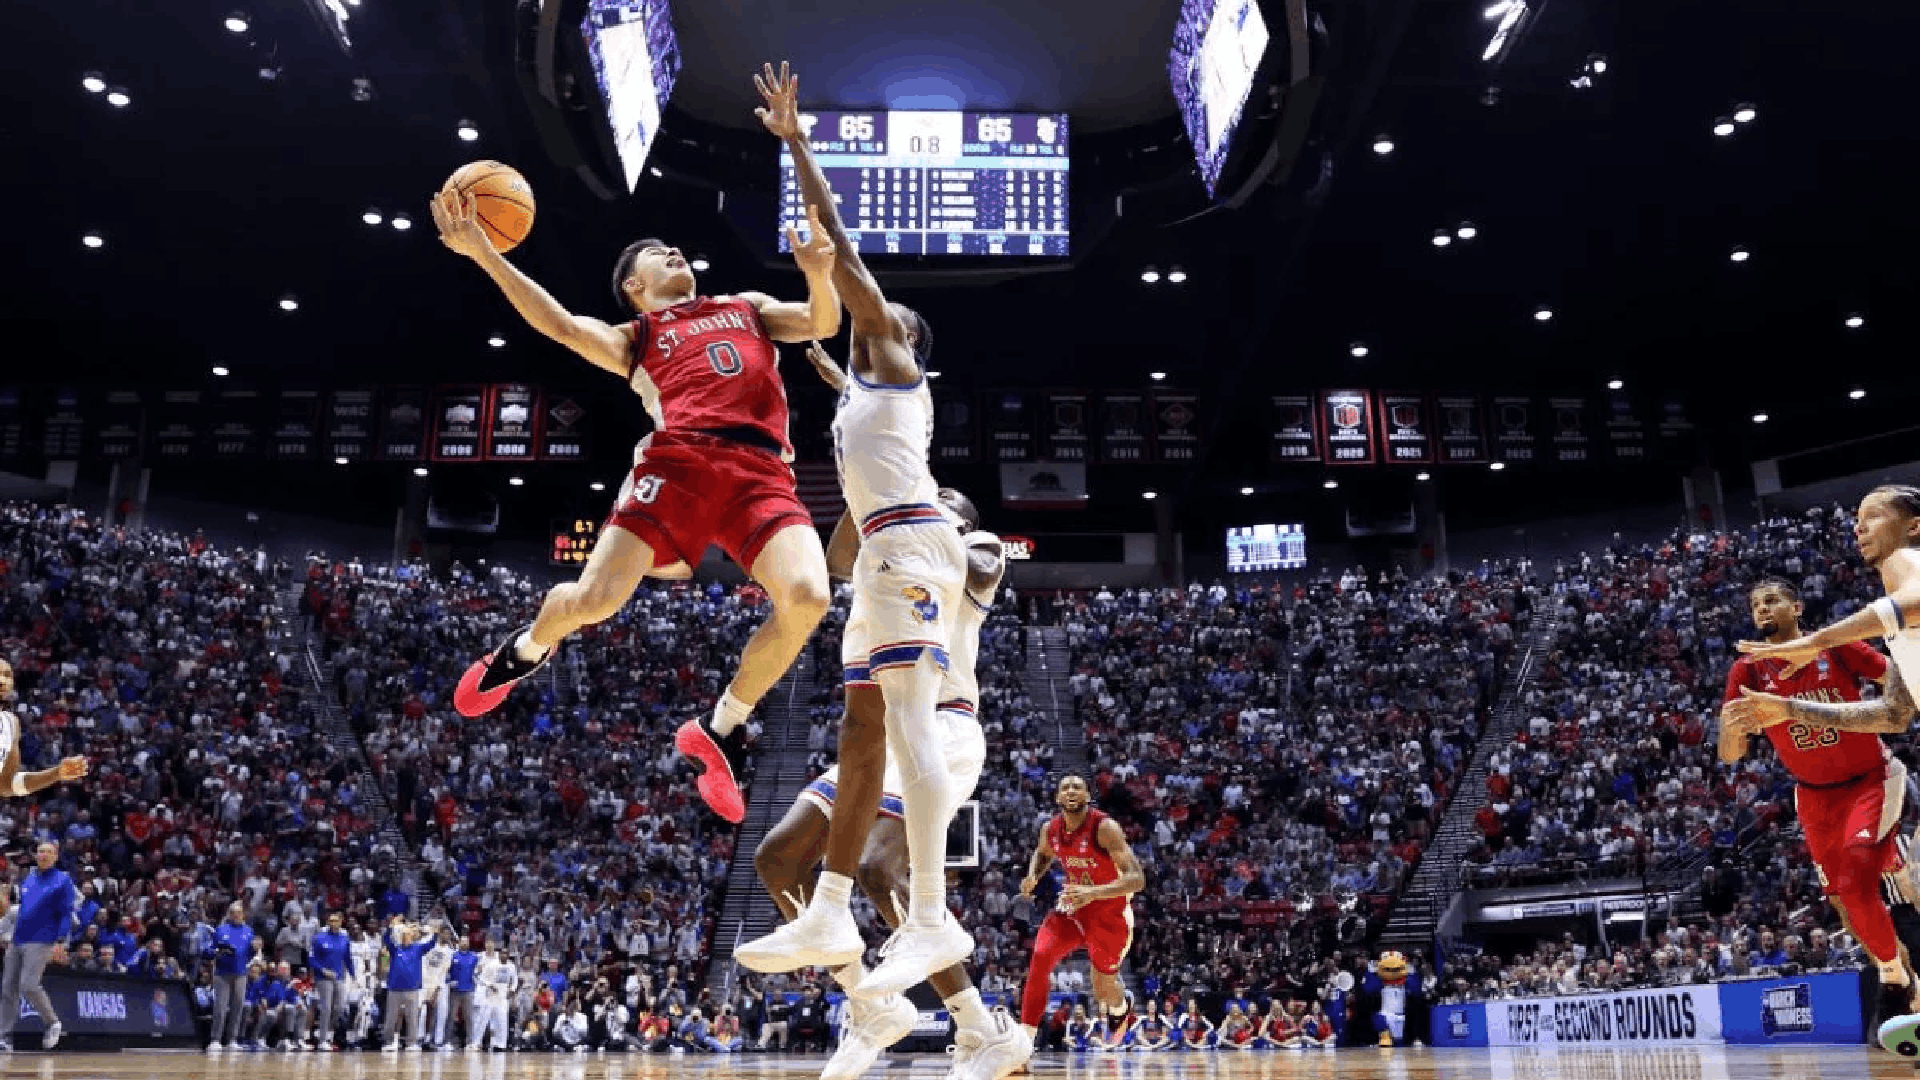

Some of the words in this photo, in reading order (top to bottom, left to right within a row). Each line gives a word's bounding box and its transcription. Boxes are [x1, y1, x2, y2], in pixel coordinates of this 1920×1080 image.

[838, 114, 874, 141] 65
[978, 117, 1013, 142] 65
[909, 135, 941, 154] 0.8
[656, 328, 686, 359] ST.
[705, 340, 743, 377] 0
[1788, 724, 1840, 751] 23
[77, 990, 127, 1020] KANSAS
[1507, 1004, 1539, 1042] FIRST
[1554, 999, 1611, 1041] SECOND
[1612, 993, 1697, 1039] ROUNDS
